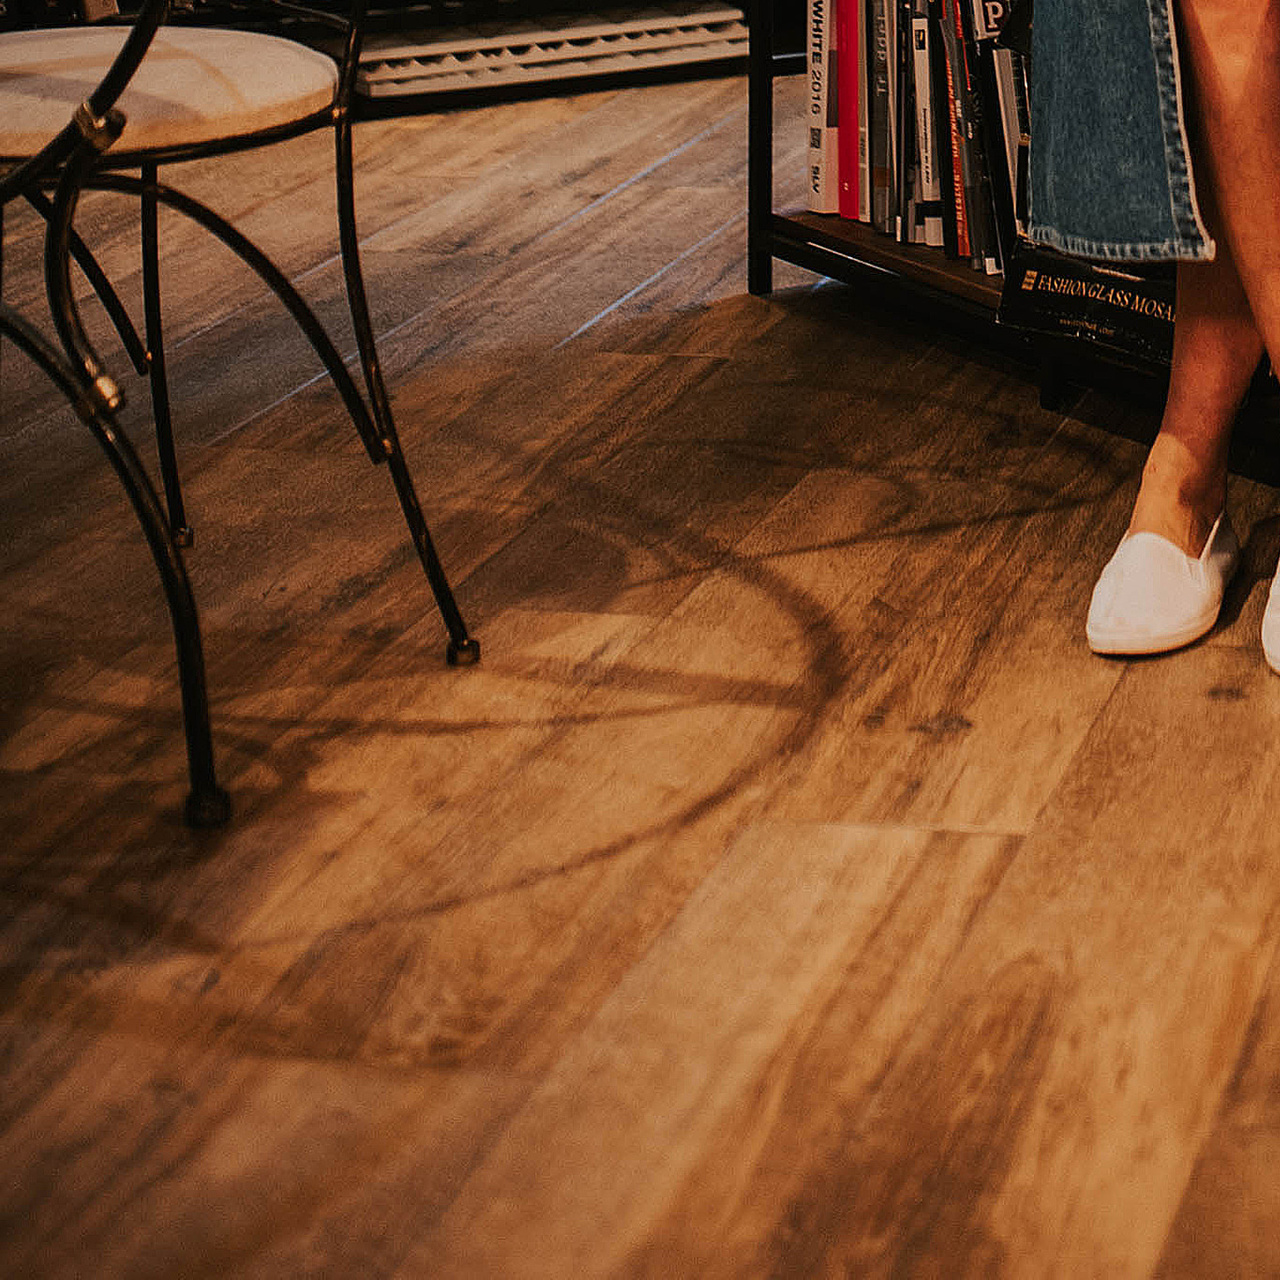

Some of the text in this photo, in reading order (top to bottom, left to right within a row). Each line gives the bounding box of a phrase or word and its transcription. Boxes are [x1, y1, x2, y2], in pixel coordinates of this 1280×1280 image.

[813, 0, 823, 64] WHITE
[811, 165, 820, 194] SLV
[1131, 296, 1176, 323] MOSA
